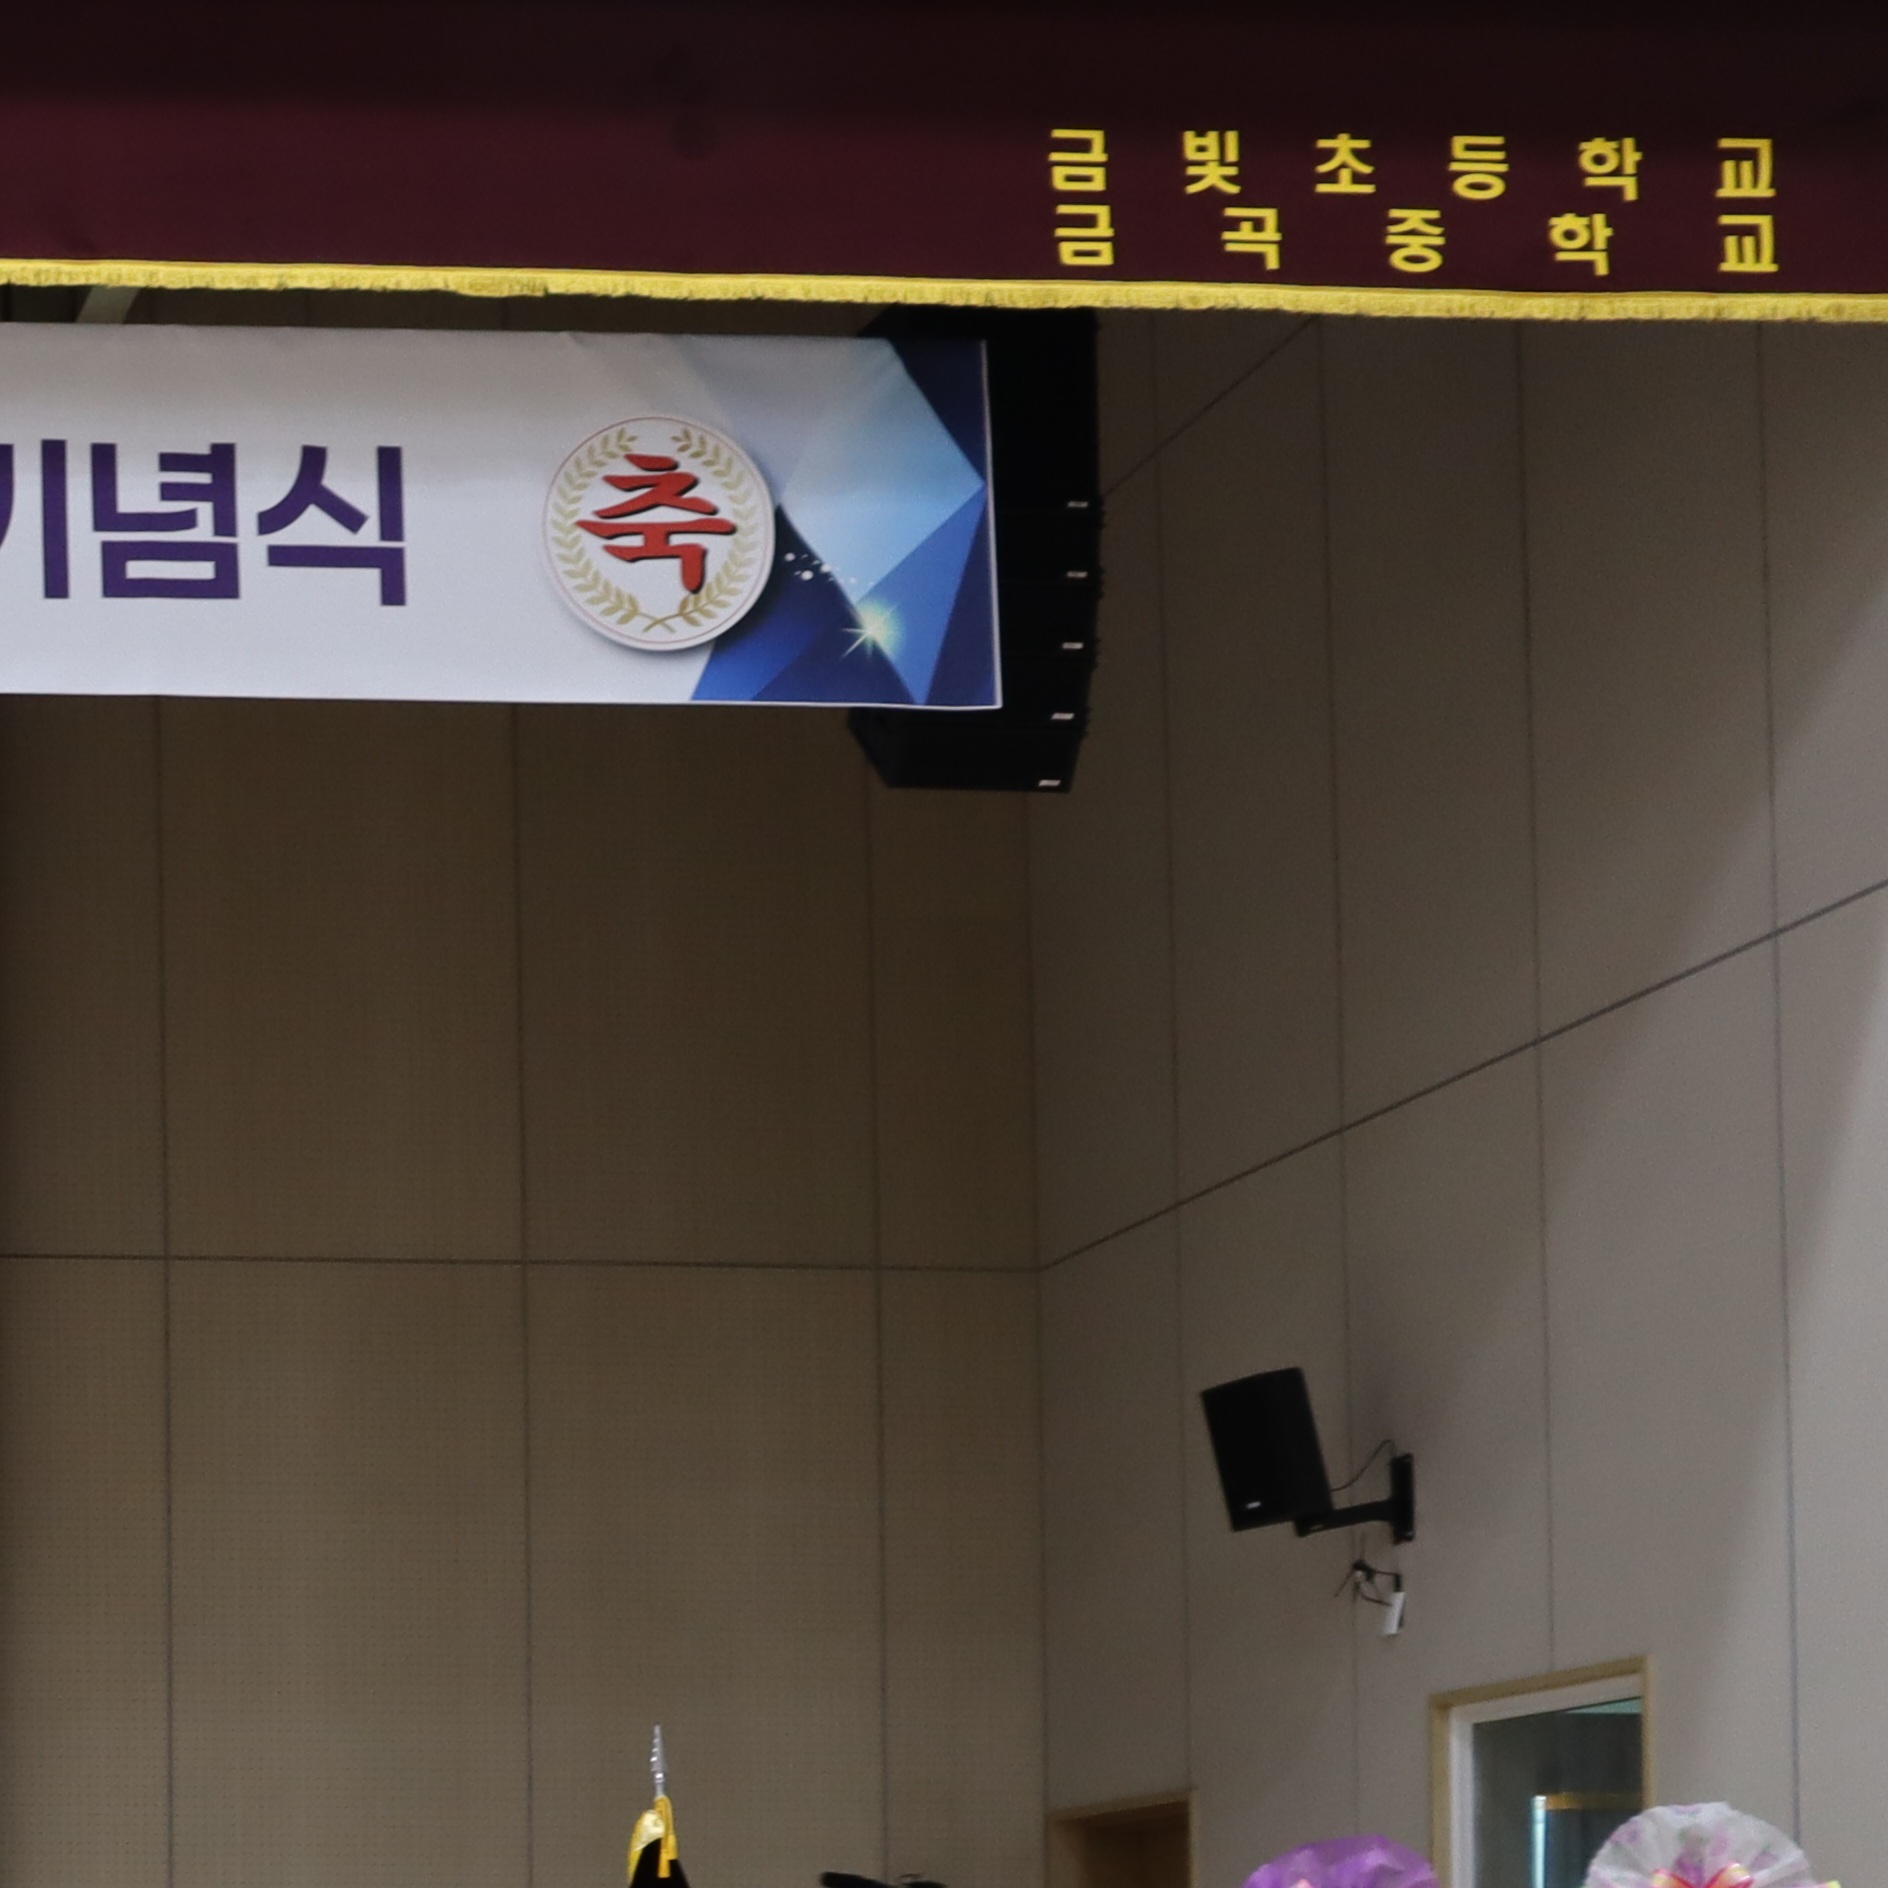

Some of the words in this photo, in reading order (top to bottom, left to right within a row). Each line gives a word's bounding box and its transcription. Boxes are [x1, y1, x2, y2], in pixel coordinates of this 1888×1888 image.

[1049, 129, 1775, 202] 금빛초등학교
[1054, 204, 1779, 276] 금곡중학교
[577, 455, 735, 593] 축
